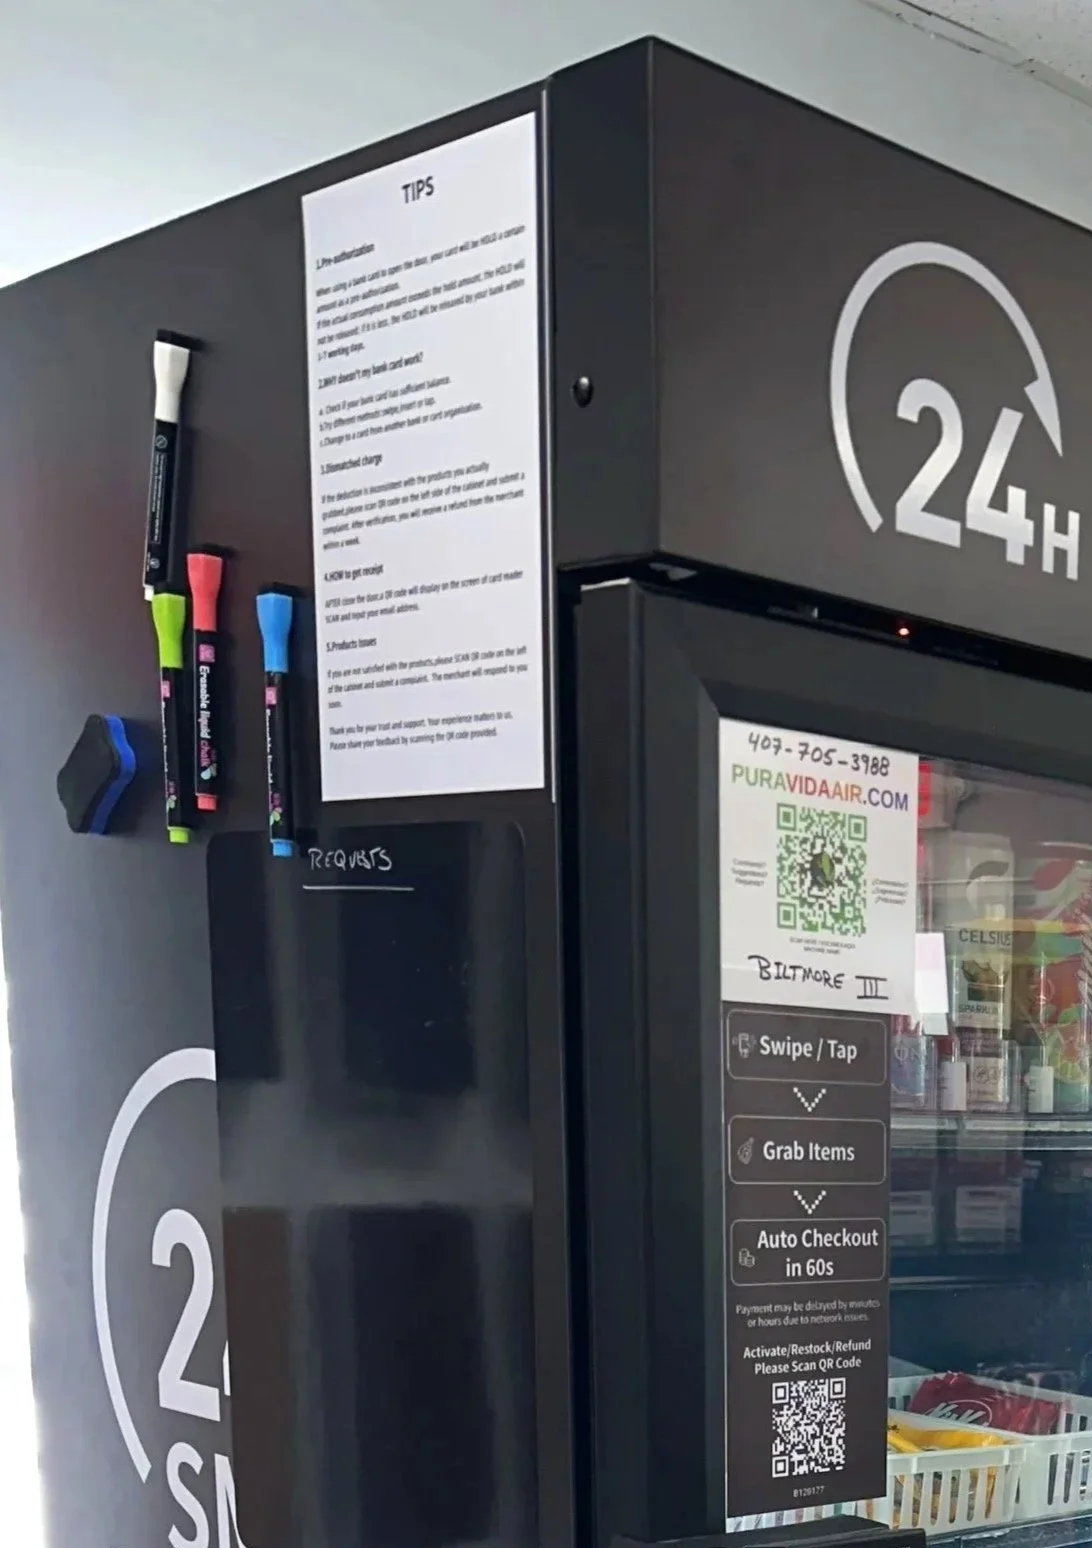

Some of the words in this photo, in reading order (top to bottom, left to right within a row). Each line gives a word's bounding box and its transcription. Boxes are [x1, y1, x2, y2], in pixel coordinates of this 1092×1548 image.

[402, 176, 434, 204] TIPS
[344, 569, 350, 580] to
[352, 567, 361, 581] get
[362, 563, 383, 579] receipt
[198, 665, 210, 709] Erasable
[198, 711, 211, 738] liquid
[199, 740, 210, 768] chalk
[748, 731, 890, 777] 407-705-3988
[731, 763, 909, 812] PURAVIDAAIR.COM
[958, 927, 1011, 947] CELSIUS
[748, 955, 845, 990] BILTMORE
[759, 1035, 813, 1061] Swipe
[827, 1040, 857, 1064] Tap
[763, 1141, 805, 1161] Grab
[809, 1142, 855, 1161] Items
[757, 1230, 797, 1249] Auto
[801, 1228, 879, 1248] Checkout
[785, 1258, 803, 1277] in
[806, 1259, 834, 1276] 60s
[736, 1304, 773, 1316] Payment
[774, 1304, 791, 1315] may
[793, 1301, 804, 1312] be
[805, 1300, 836, 1313] delayed
[838, 1299, 848, 1311] by
[849, 1299, 880, 1309] minutes
[747, 1318, 757, 1328] or
[758, 1316, 782, 1327] hours
[783, 1315, 798, 1326] due
[800, 1314, 809, 1325] to
[810, 1313, 843, 1324] network
[743, 1339, 872, 1359] Activate/Restock/Refund
[755, 1362, 789, 1375] Please
[791, 1359, 817, 1373] Scan
[819, 1358, 834, 1373] QR
[835, 1357, 862, 1370] Code
